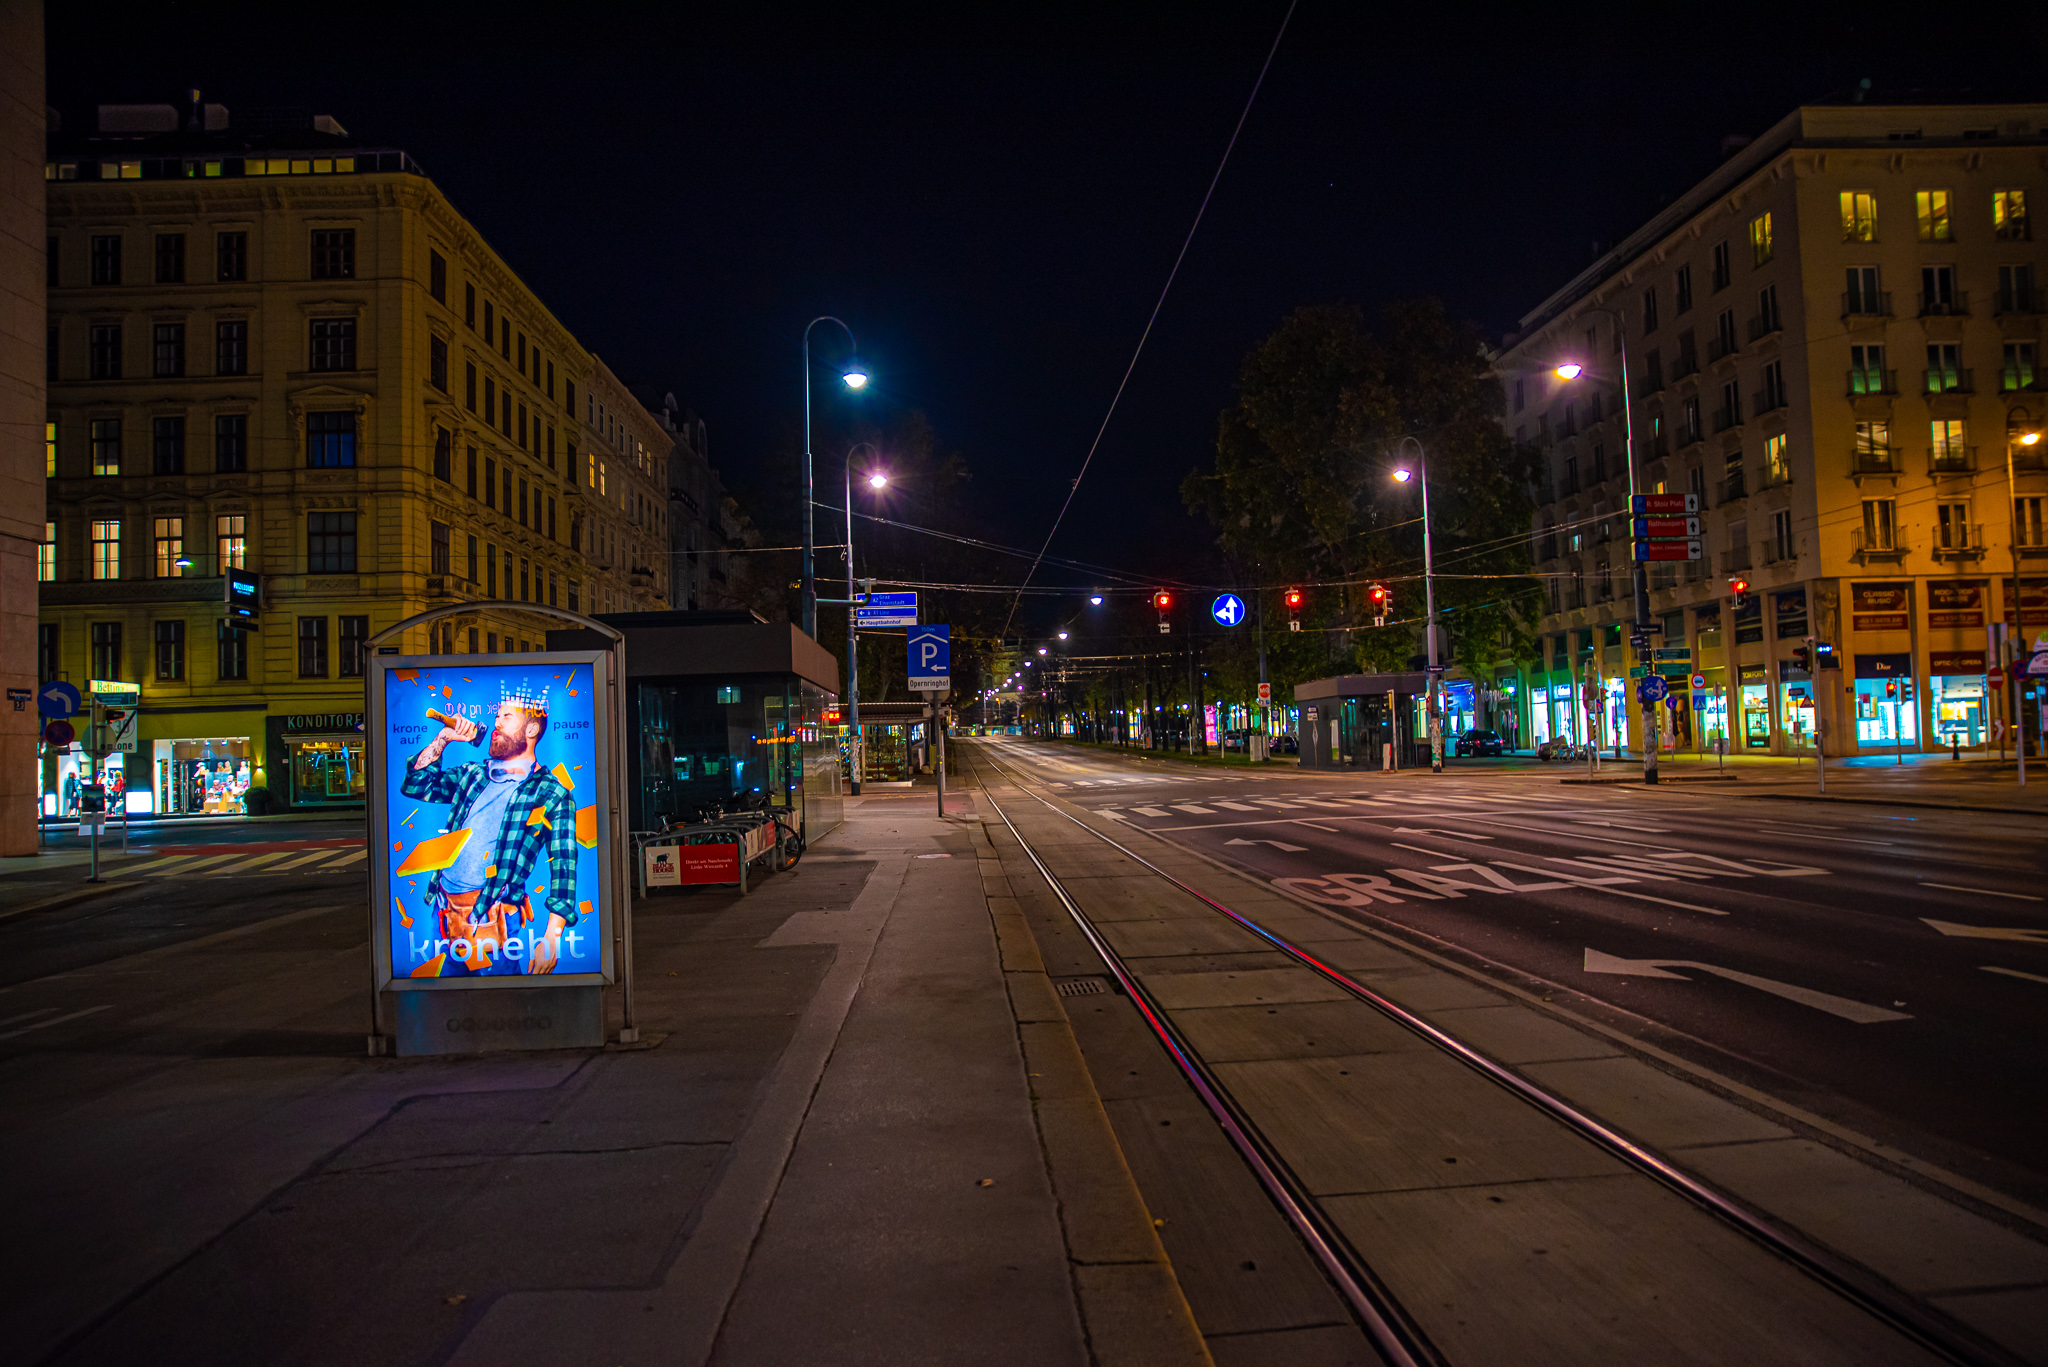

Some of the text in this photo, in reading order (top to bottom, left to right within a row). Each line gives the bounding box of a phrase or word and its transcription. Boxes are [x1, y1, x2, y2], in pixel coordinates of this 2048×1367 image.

[921, 643, 938, 667] P
[1876, 662, 1891, 670] Dior
[97, 681, 125, 693] Bettina
[909, 679, 949, 688] Opernringhof
[393, 723, 428, 733] krone
[553, 720, 590, 731] pause
[400, 734, 421, 745] auf
[564, 731, 579, 740] an
[1270, 852, 1832, 907] GRAZ LINZ
[409, 927, 586, 963] kronehit
